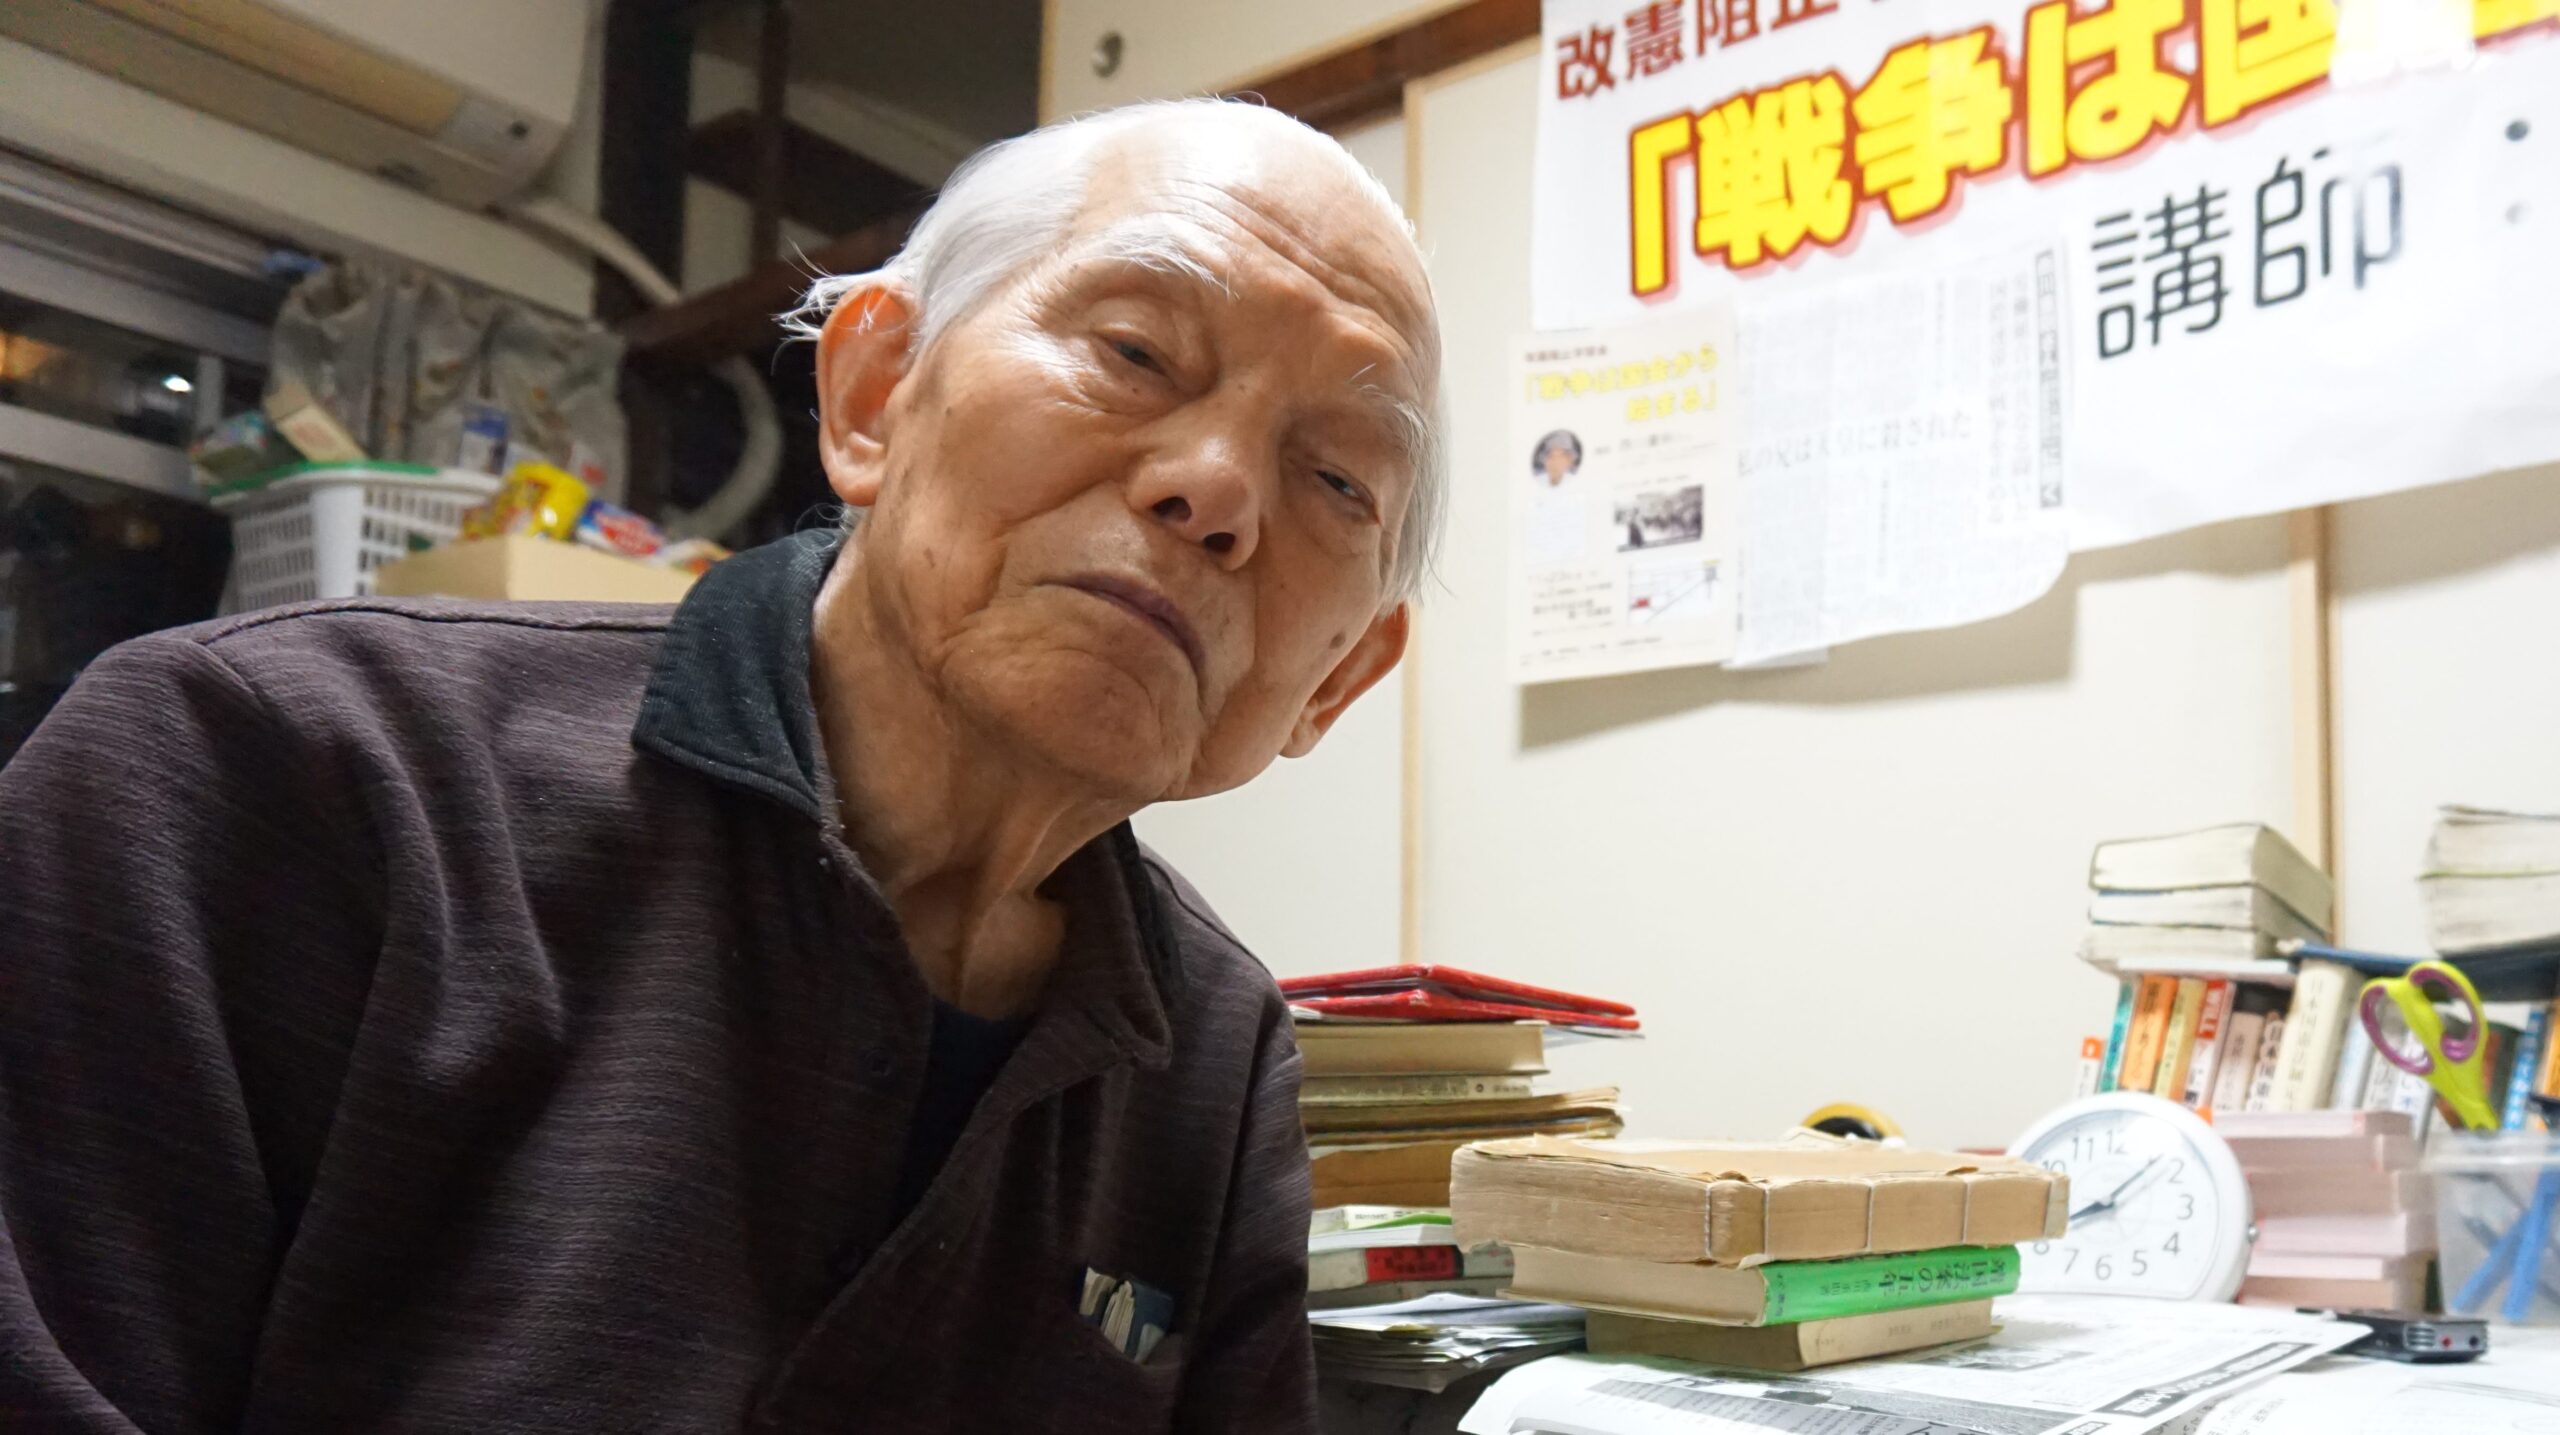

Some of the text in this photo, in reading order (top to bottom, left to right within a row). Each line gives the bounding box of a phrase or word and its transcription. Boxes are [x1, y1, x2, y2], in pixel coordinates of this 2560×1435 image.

[2091, 148, 2402, 359] 講師
[2072, 1137, 2094, 1162] 11
[2168, 1157, 2185, 1184] 2
[2176, 1193, 2195, 1221] 3
[2161, 1231, 2181, 1256] 4
[2064, 1248, 2080, 1275] 7
[2094, 1254, 2113, 1281] 6
[2131, 1249, 2148, 1277] 5
